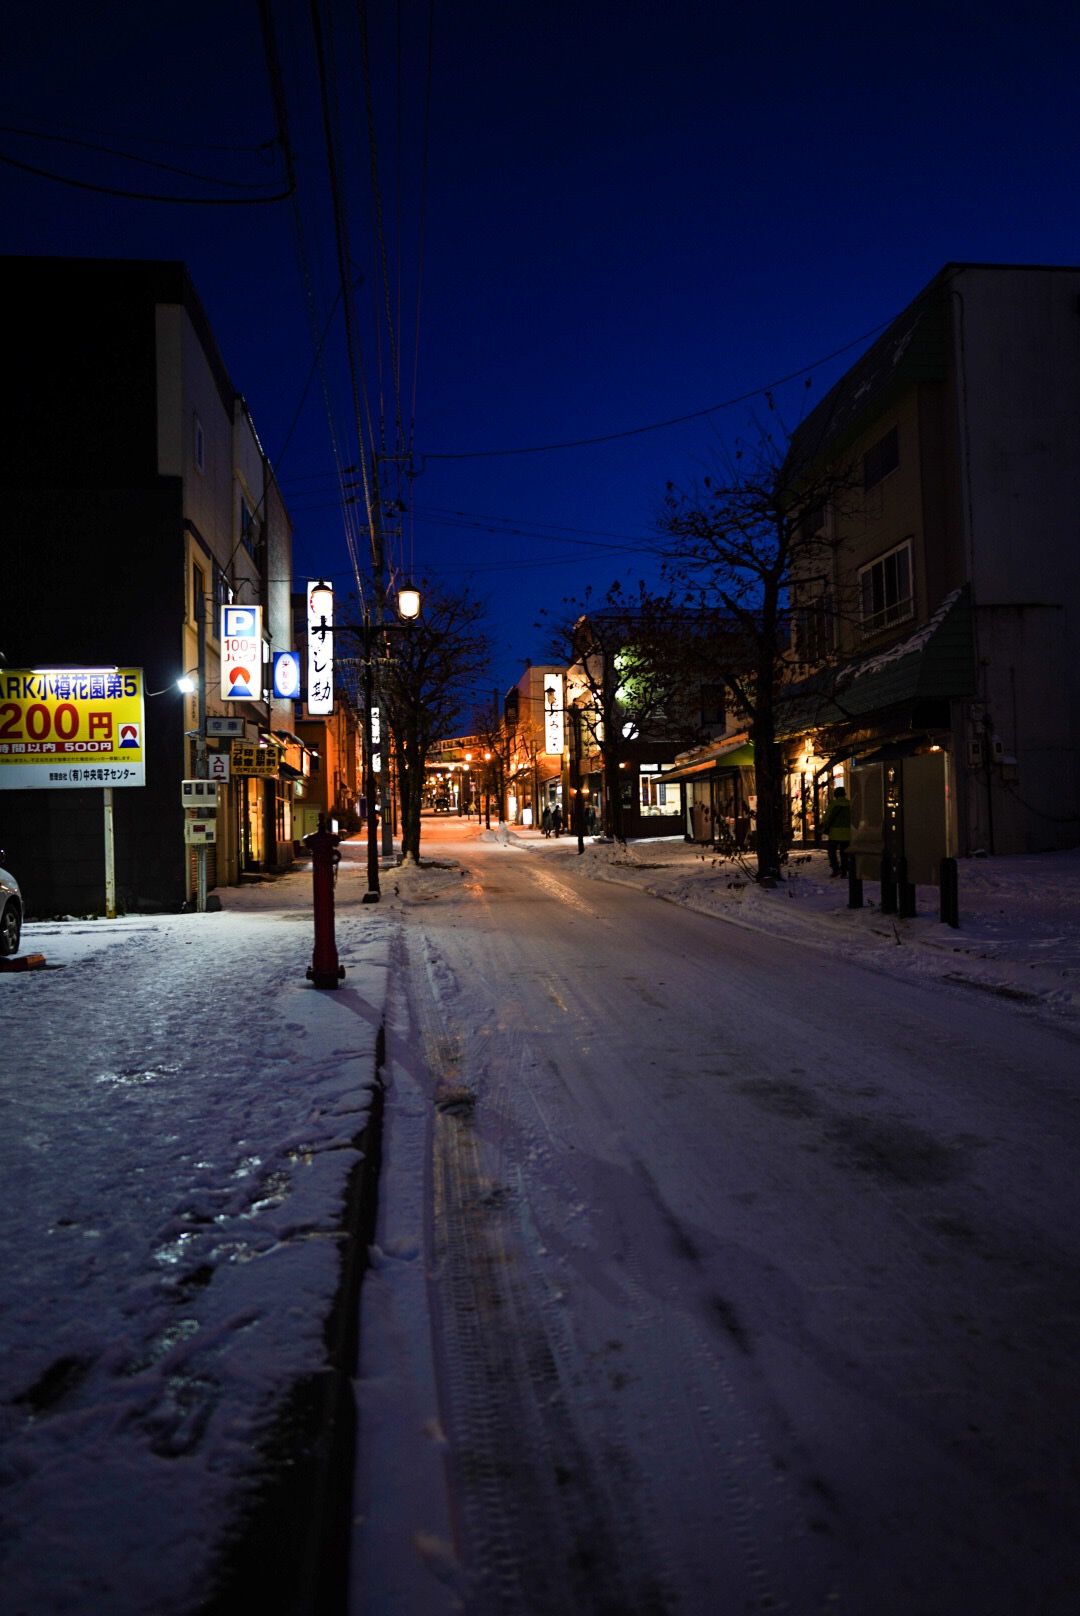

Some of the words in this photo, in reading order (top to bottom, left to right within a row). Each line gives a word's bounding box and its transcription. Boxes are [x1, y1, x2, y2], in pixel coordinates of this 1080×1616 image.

[228, 610, 254, 635] P
[64, 741, 112, 752] 500円
[213, 756, 224, 773] 入口
